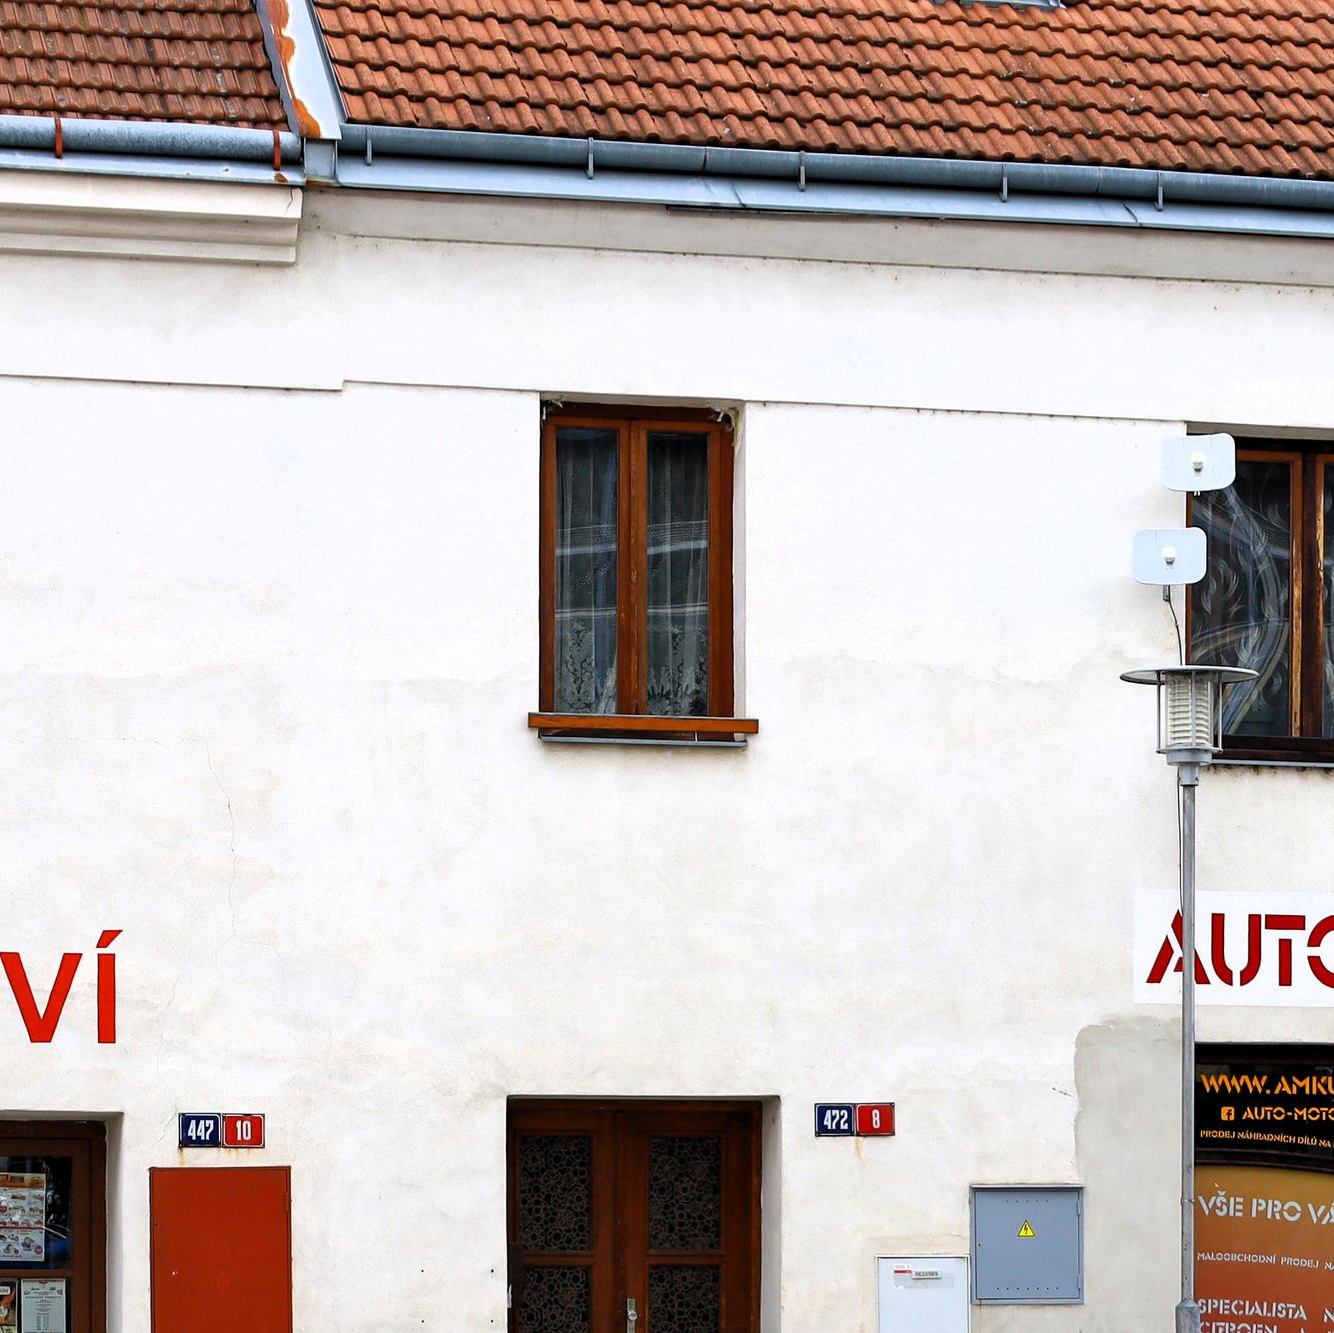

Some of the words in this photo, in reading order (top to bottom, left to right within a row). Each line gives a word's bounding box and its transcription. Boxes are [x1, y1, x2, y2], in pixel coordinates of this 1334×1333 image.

[823, 1109, 849, 1130] 472
[871, 1109, 880, 1129] 8
[187, 1119, 214, 1141] 447
[235, 1120, 252, 1141] 10
[1200, 1130, 1236, 1139] PRODEJ
[1237, 1130, 1296, 1144] NÁHRADNÍCH
[1297, 1133, 1317, 1146] DÍLŮ
[1318, 1139, 1332, 1148] NA
[1197, 1190, 1244, 1218] VŠE
[1251, 1198, 1302, 1222] PRO
[1196, 1252, 1277, 1265] MALOOBCHODNÍ
[1280, 1256, 1319, 1269] PRODEJ
[1197, 1298, 1308, 1321] SPECIALISTA
